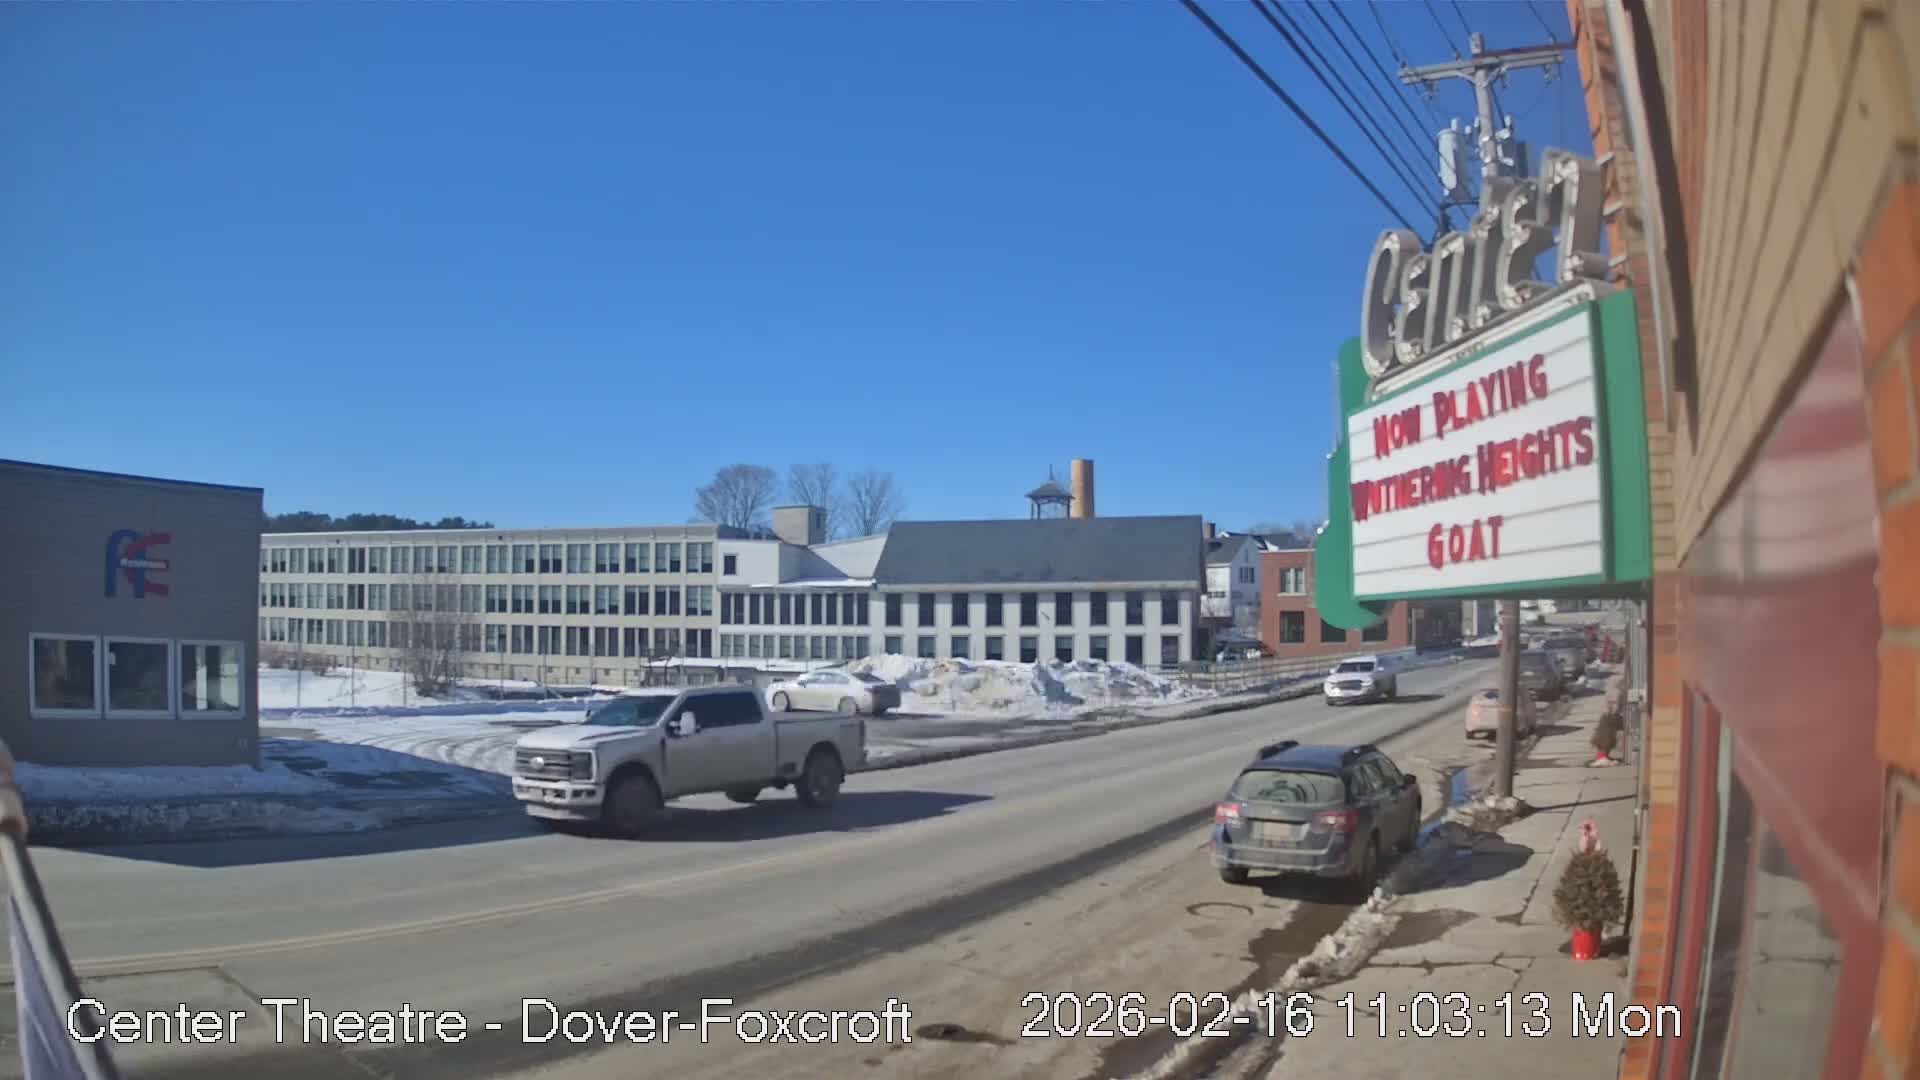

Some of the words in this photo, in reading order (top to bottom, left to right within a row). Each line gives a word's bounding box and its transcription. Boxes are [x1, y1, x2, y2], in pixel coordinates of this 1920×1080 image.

[1433, 354, 1548, 439] PLAYING
[1477, 415, 1594, 495] HEIGHTS
[1428, 514, 1504, 570] GOAT
